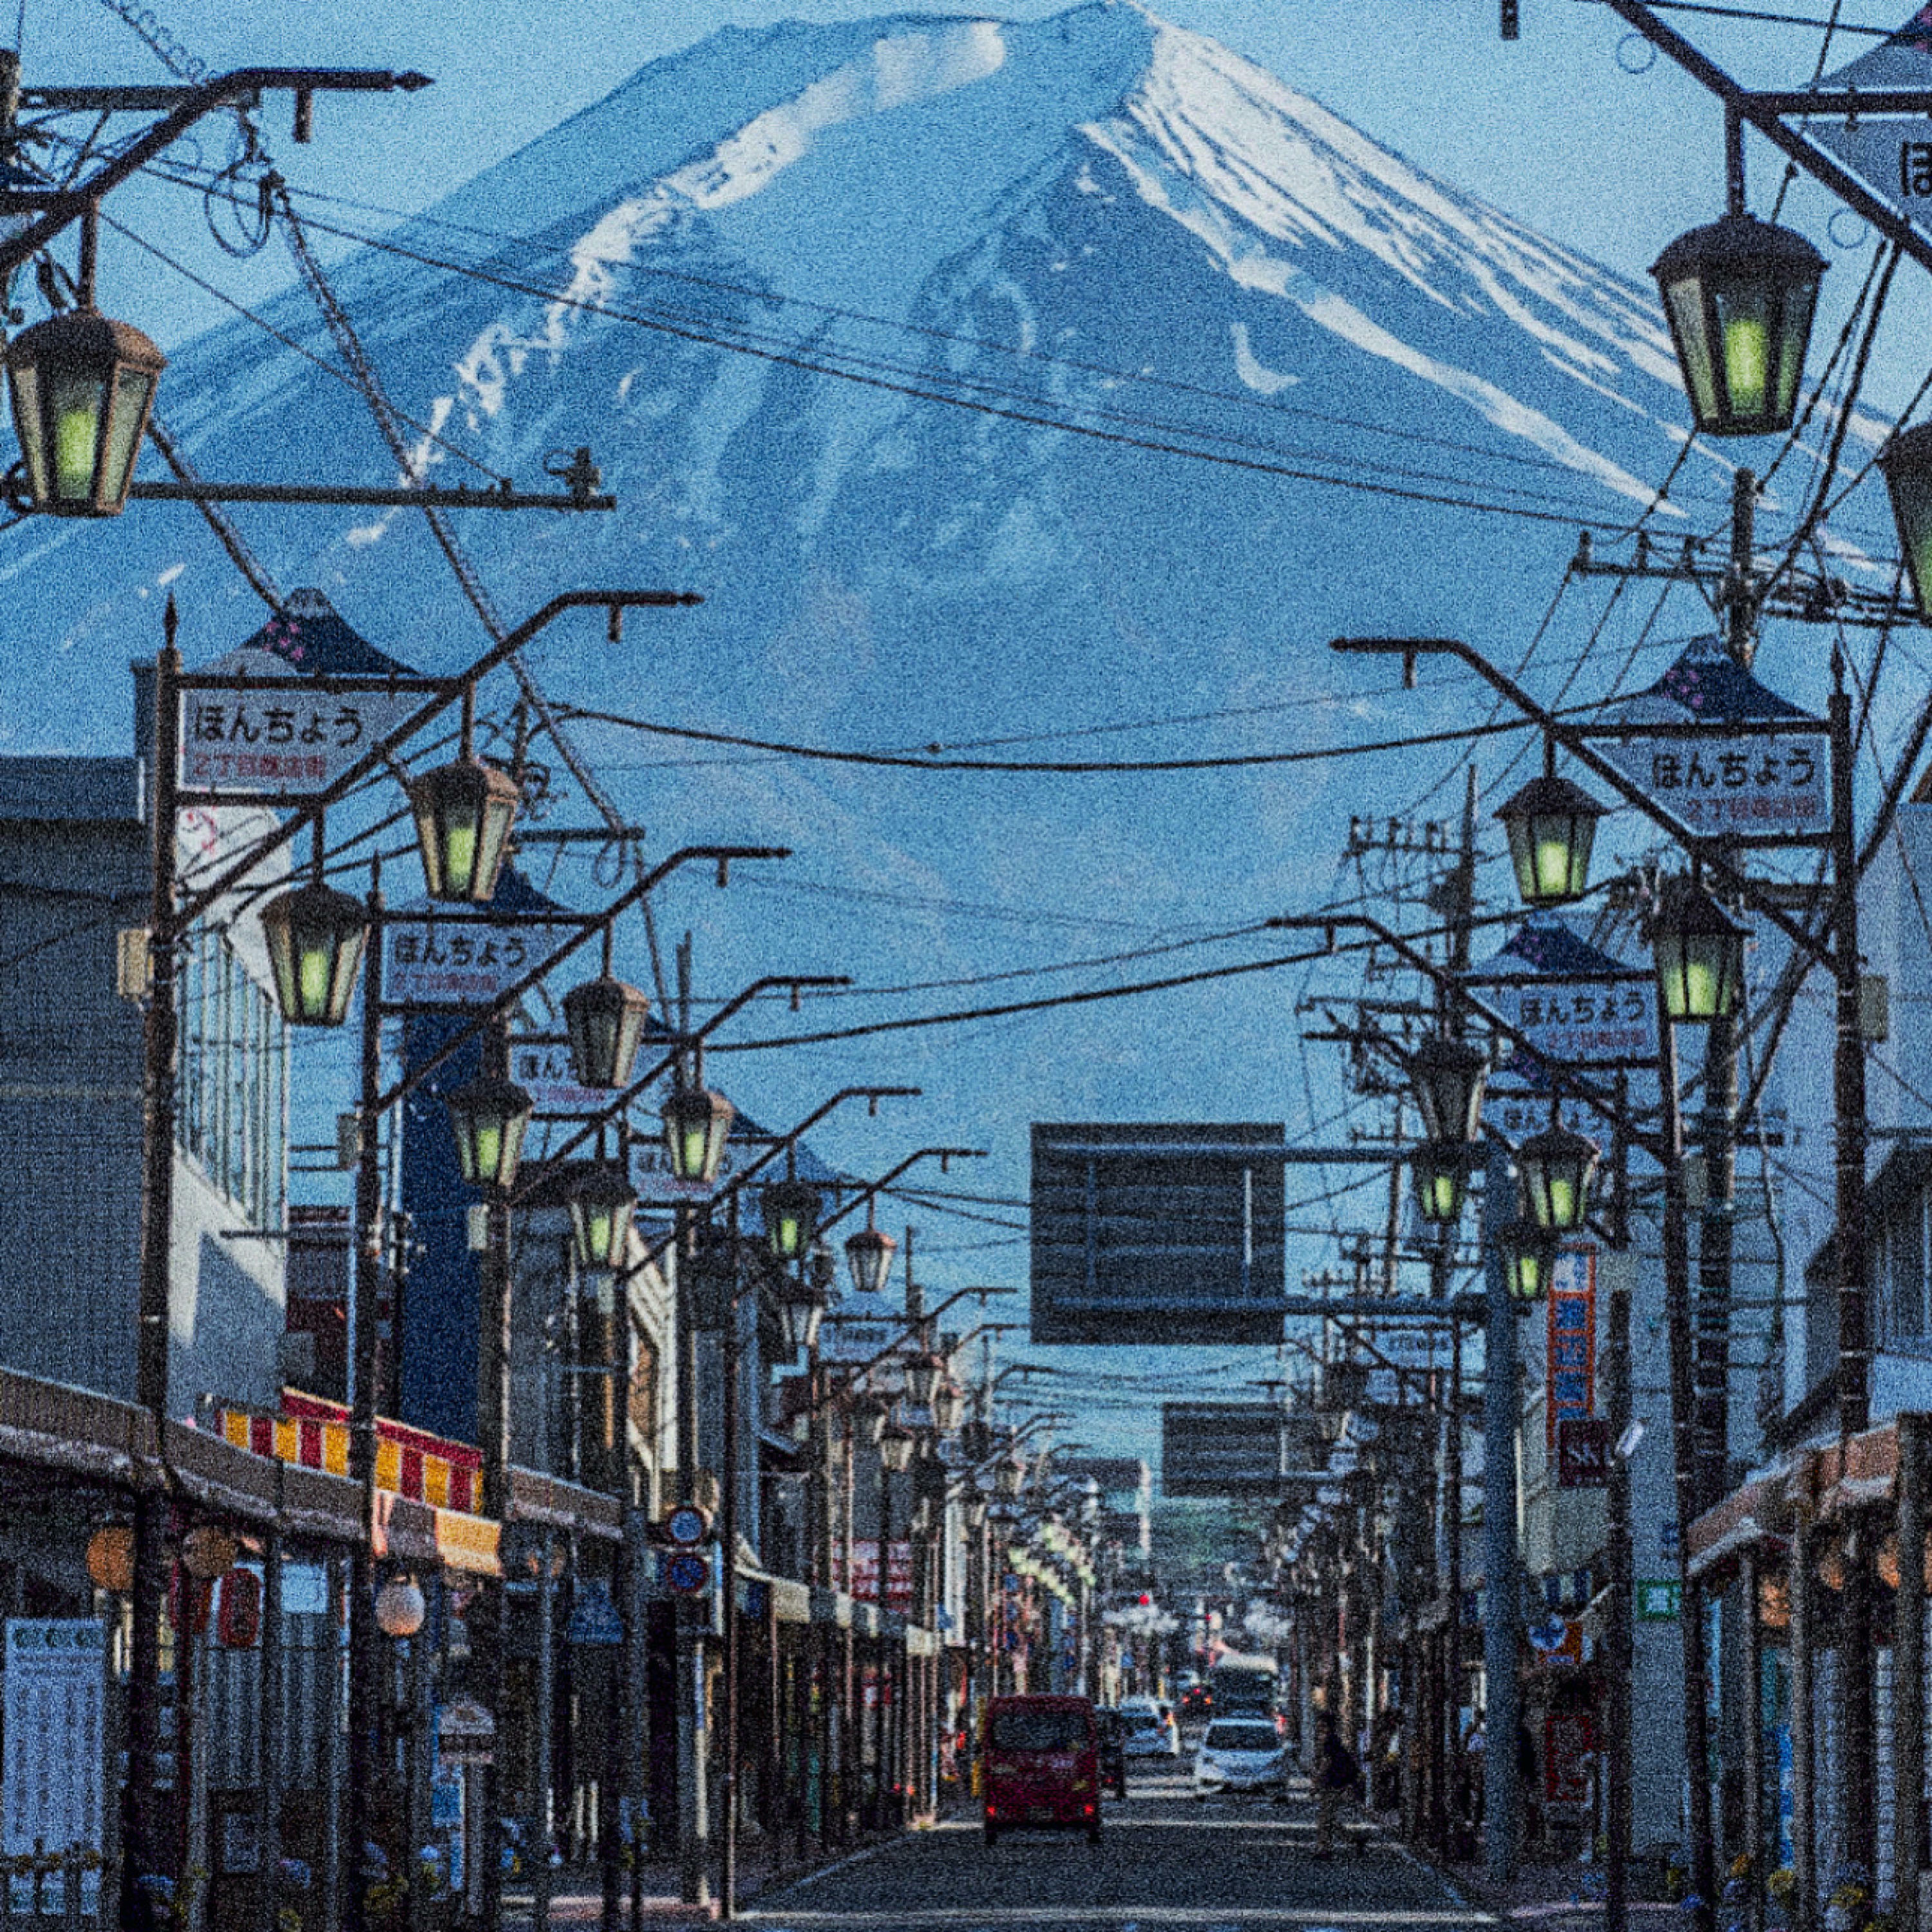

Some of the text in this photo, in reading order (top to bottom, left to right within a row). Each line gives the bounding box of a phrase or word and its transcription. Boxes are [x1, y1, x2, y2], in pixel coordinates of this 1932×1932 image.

[196, 706, 362, 748] ほんちょう
[1653, 747, 1815, 789] ほんちょう
[394, 935, 527, 967] ほんちょう
[1520, 991, 1645, 1025] ほんちょう
